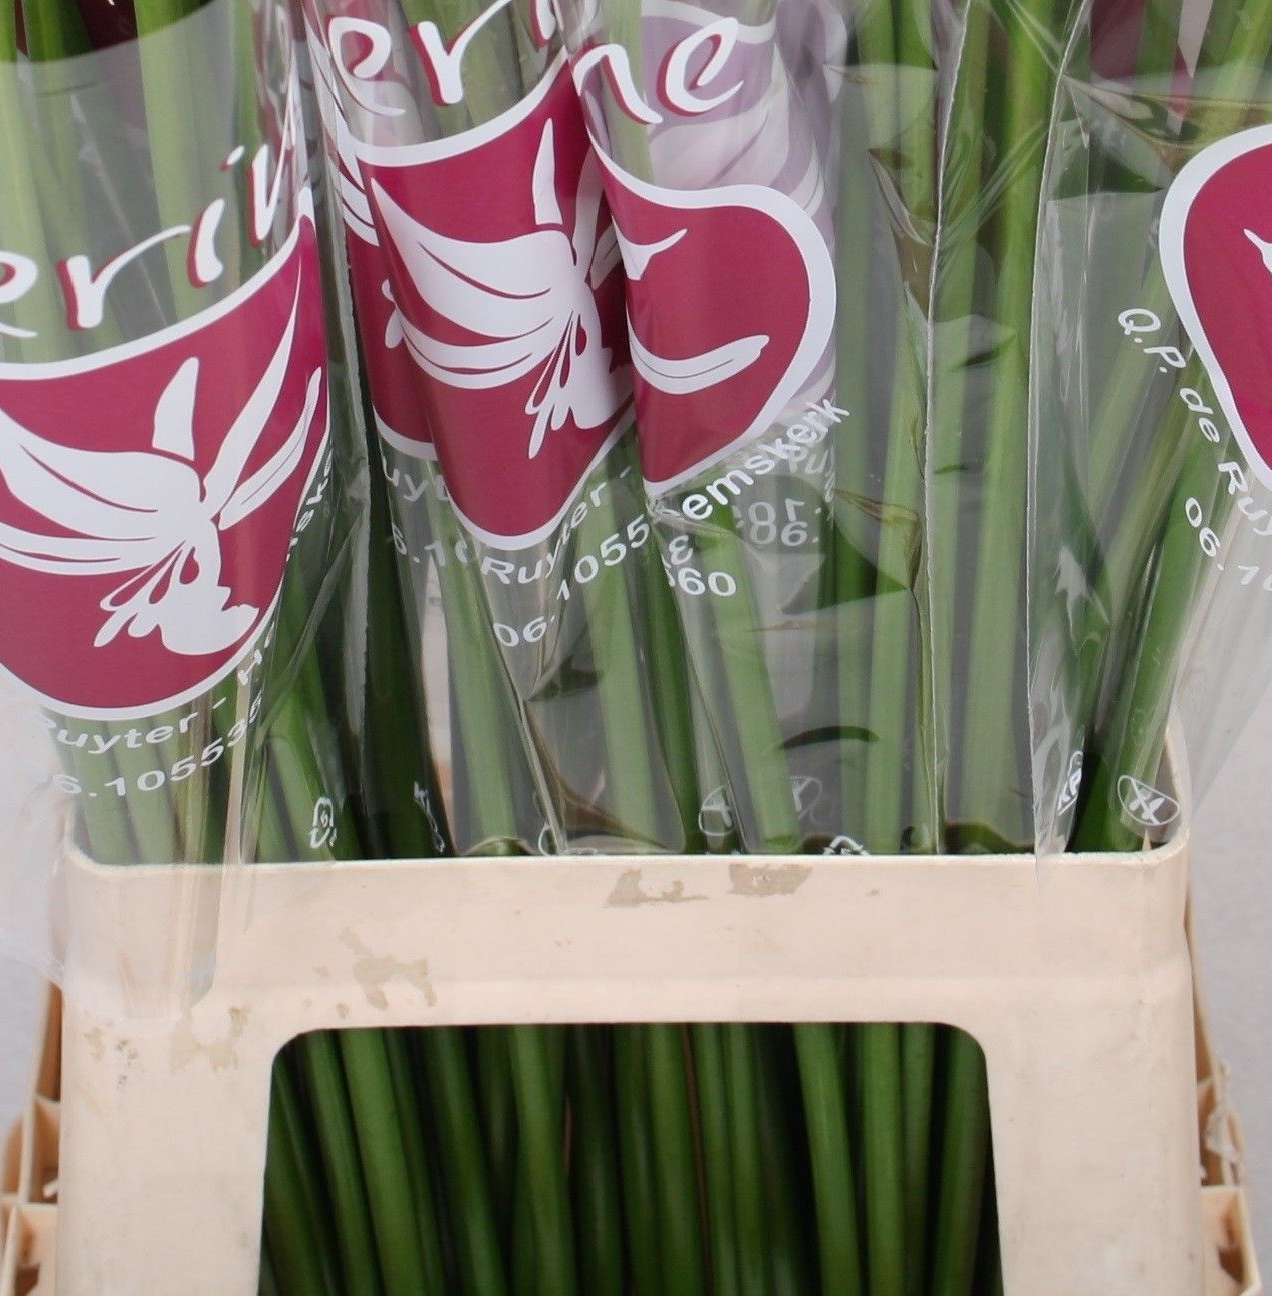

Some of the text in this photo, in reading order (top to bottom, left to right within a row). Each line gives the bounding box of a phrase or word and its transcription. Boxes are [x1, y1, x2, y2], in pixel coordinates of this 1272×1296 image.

[1179, 388, 1220, 443] de
[677, 399, 850, 521] emskerk
[35, 709, 199, 755] uyter
